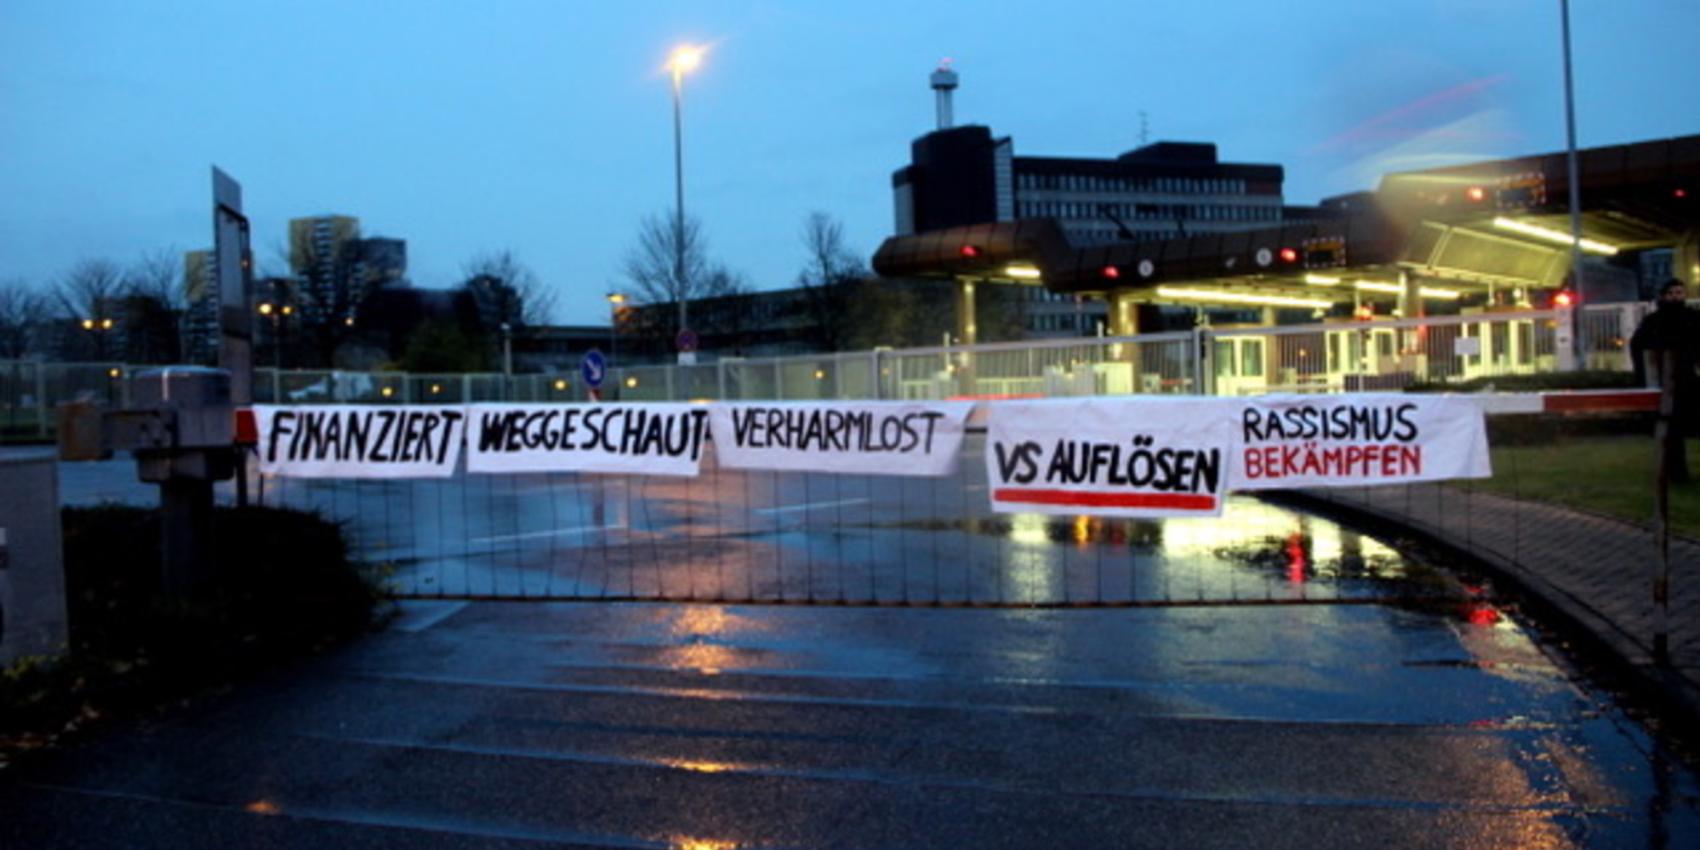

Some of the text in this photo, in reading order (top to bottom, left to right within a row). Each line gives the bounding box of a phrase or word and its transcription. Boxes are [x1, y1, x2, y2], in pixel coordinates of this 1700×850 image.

[268, 411, 461, 464] FINANZIERT
[478, 409, 707, 460] WEGGESCHAUT
[732, 408, 944, 454] VERHARMLOST
[1243, 405, 1418, 442] RASSISMUS
[994, 435, 1220, 494] VS AUFLÖSEN
[1244, 443, 1421, 478] BEKÄMPFEN
